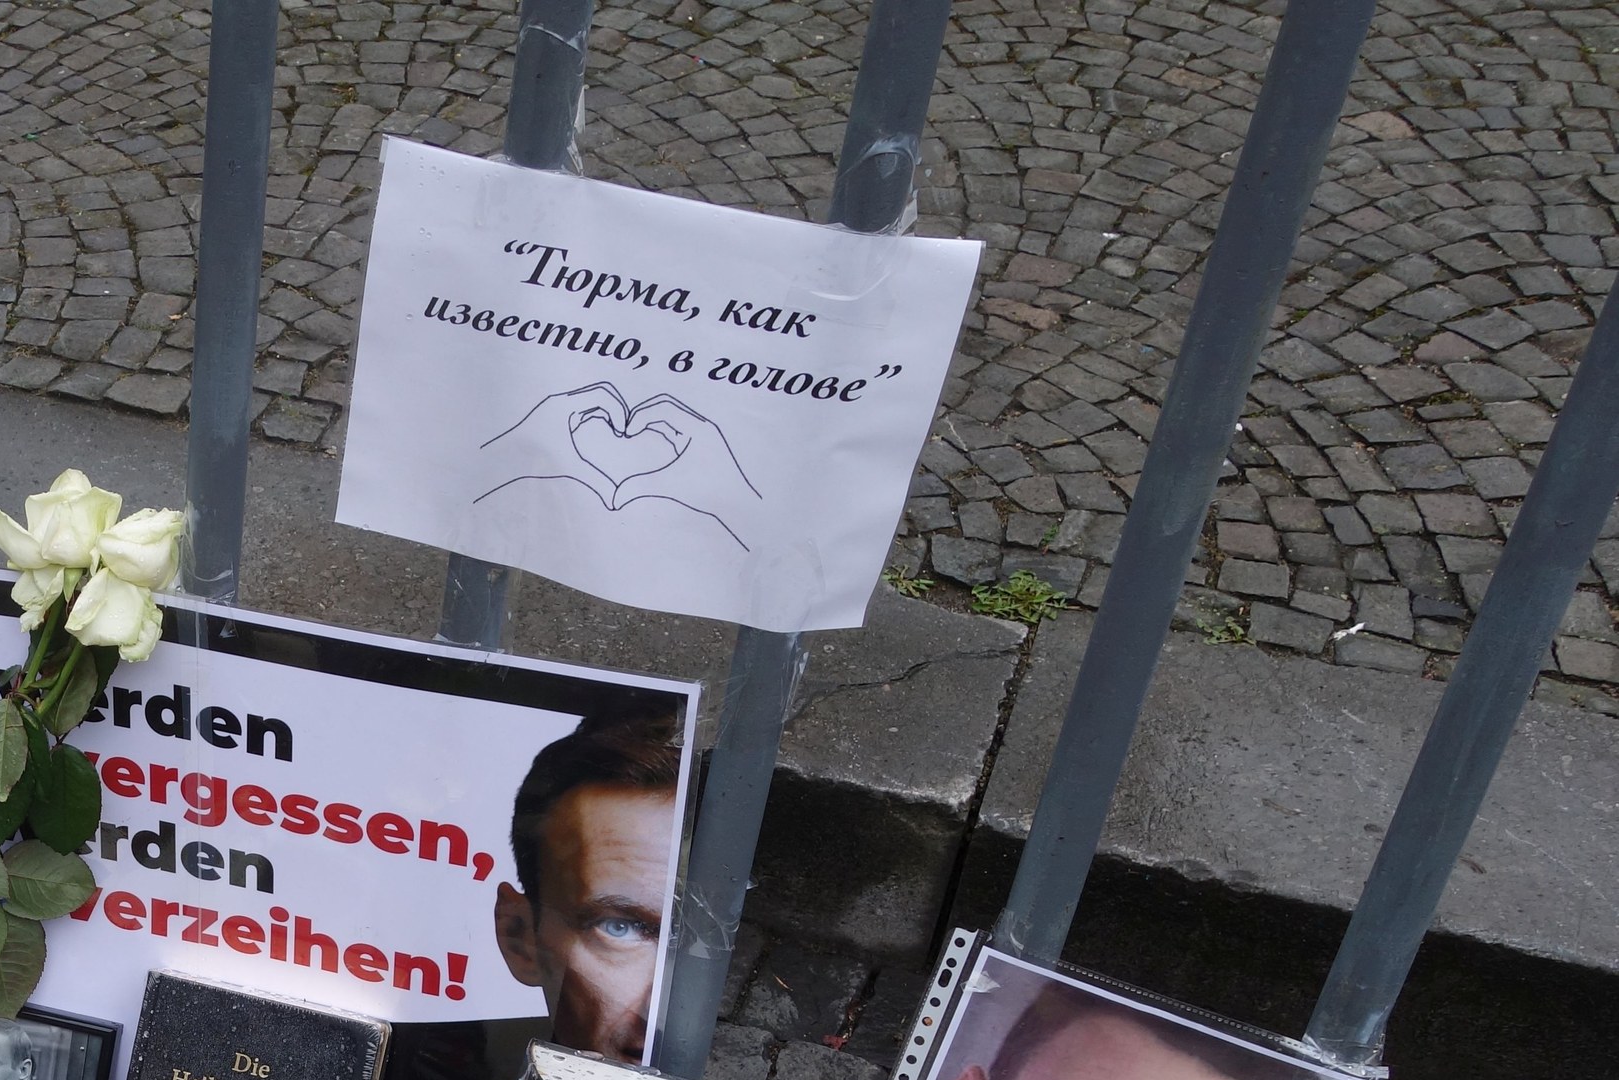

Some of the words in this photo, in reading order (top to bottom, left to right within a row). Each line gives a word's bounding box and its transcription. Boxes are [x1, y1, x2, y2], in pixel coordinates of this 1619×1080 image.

[422, 295, 651, 370] известно,
[668, 349, 694, 373] в
[708, 357, 903, 403] голове”
[718, 298, 817, 339] как
[83, 749, 494, 882] ergessen,
[231, 1052, 270, 1079] Die
